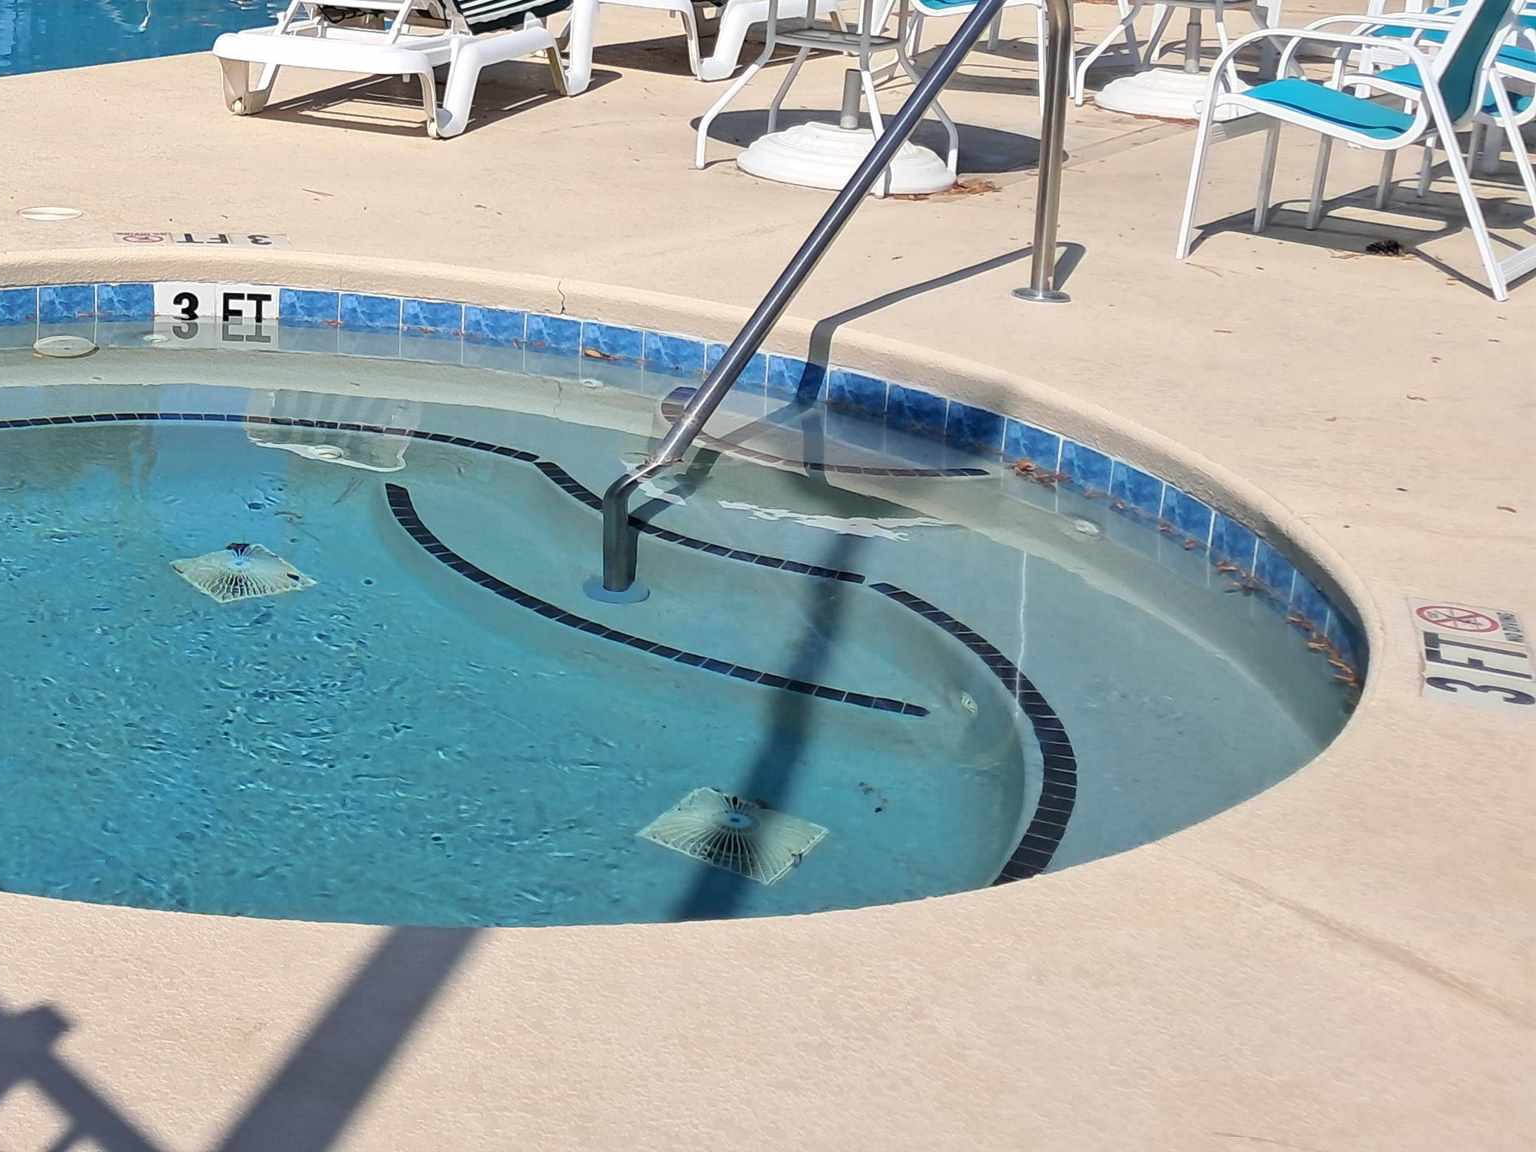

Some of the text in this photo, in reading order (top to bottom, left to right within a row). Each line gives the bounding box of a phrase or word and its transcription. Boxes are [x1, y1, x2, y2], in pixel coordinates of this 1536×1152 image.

[172, 291, 272, 323] 3 FT
[1423, 631, 1536, 705] 3 FT
